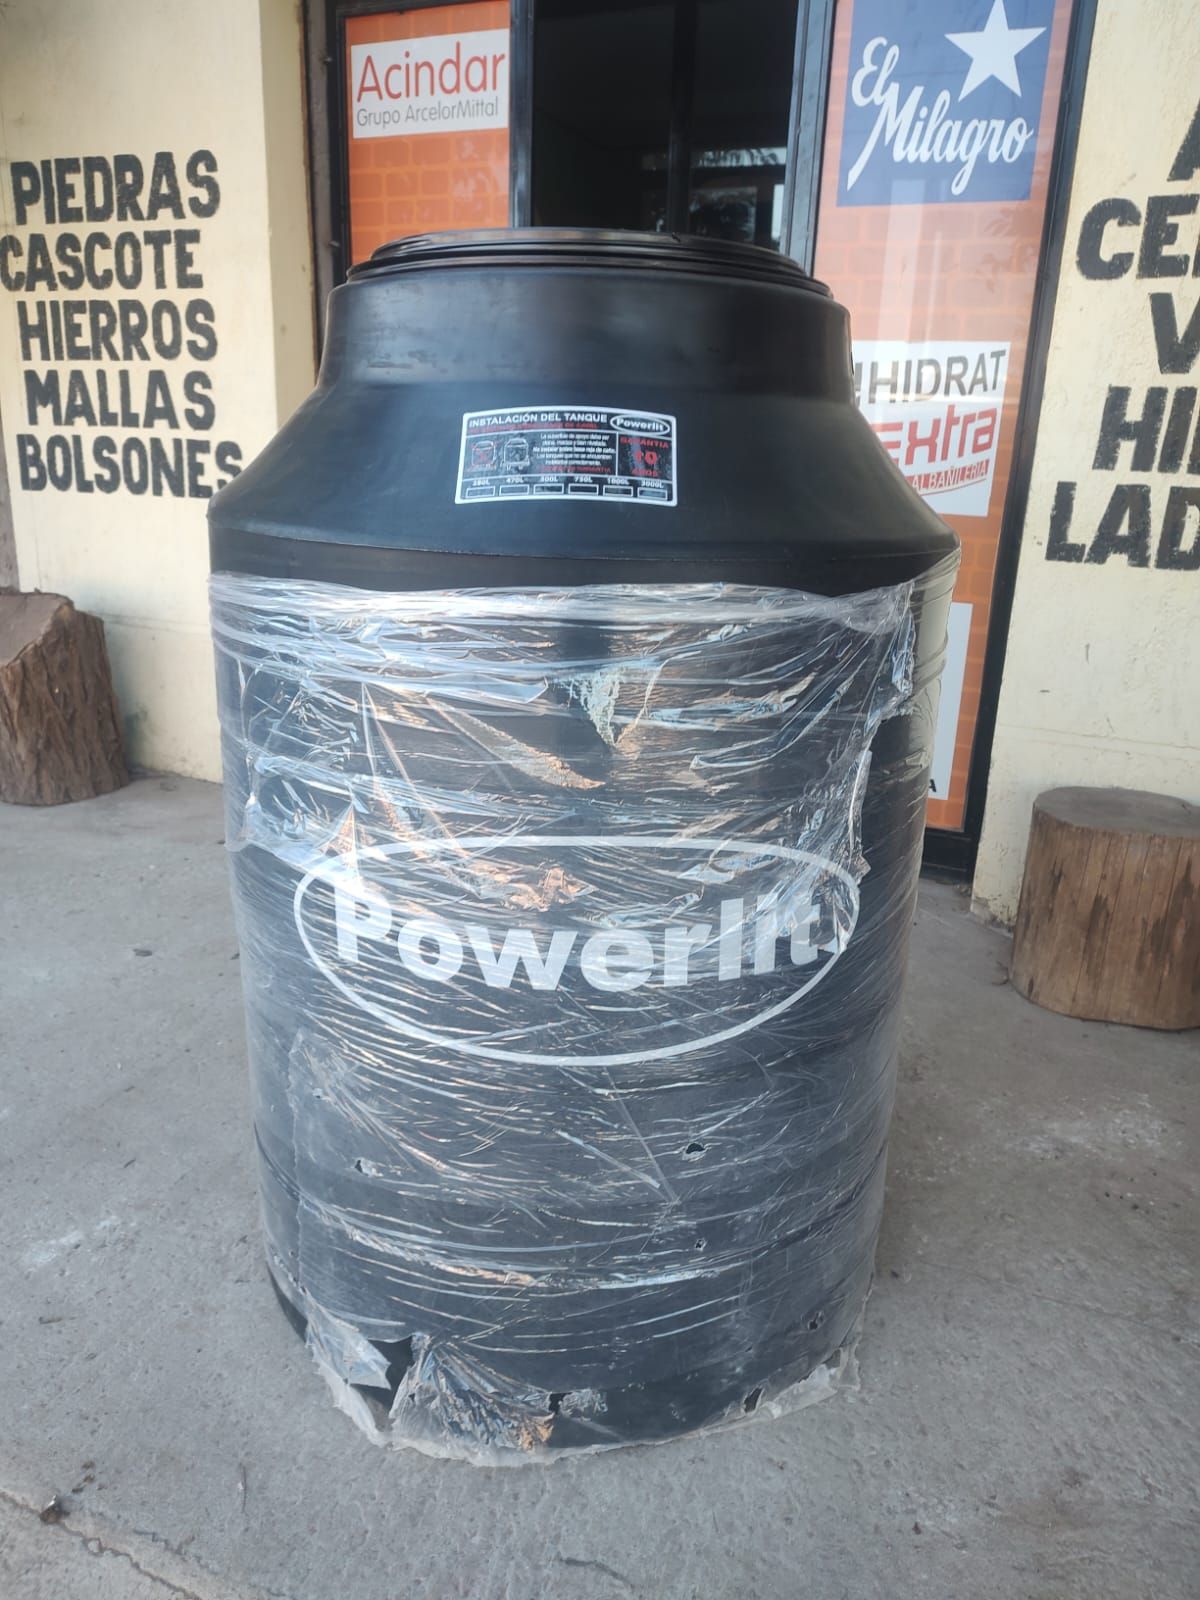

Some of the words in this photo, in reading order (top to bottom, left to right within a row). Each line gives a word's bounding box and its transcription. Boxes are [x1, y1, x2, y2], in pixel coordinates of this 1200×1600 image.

[357, 41, 505, 102] Acindar
[852, 36, 899, 106] El
[357, 108, 401, 128] Grupo
[405, 96, 498, 123] ArcelorMittal
[847, 82, 1034, 195] Milagro
[10, 150, 220, 225] PIEDRAS
[0, 229, 203, 291] CASCOTE
[1076, 194, 1200, 280] CE
[17, 298, 217, 361] HIERROS
[24, 369, 215, 430] MALLAS
[541, 411, 560, 422] DEL
[564, 412, 607, 423] TANQUE
[616, 418, 664, 431] Powerlit
[1092, 384, 1200, 475] HI
[16, 434, 243, 499] BOLSONES
[334, 880, 818, 992] Powerlit
